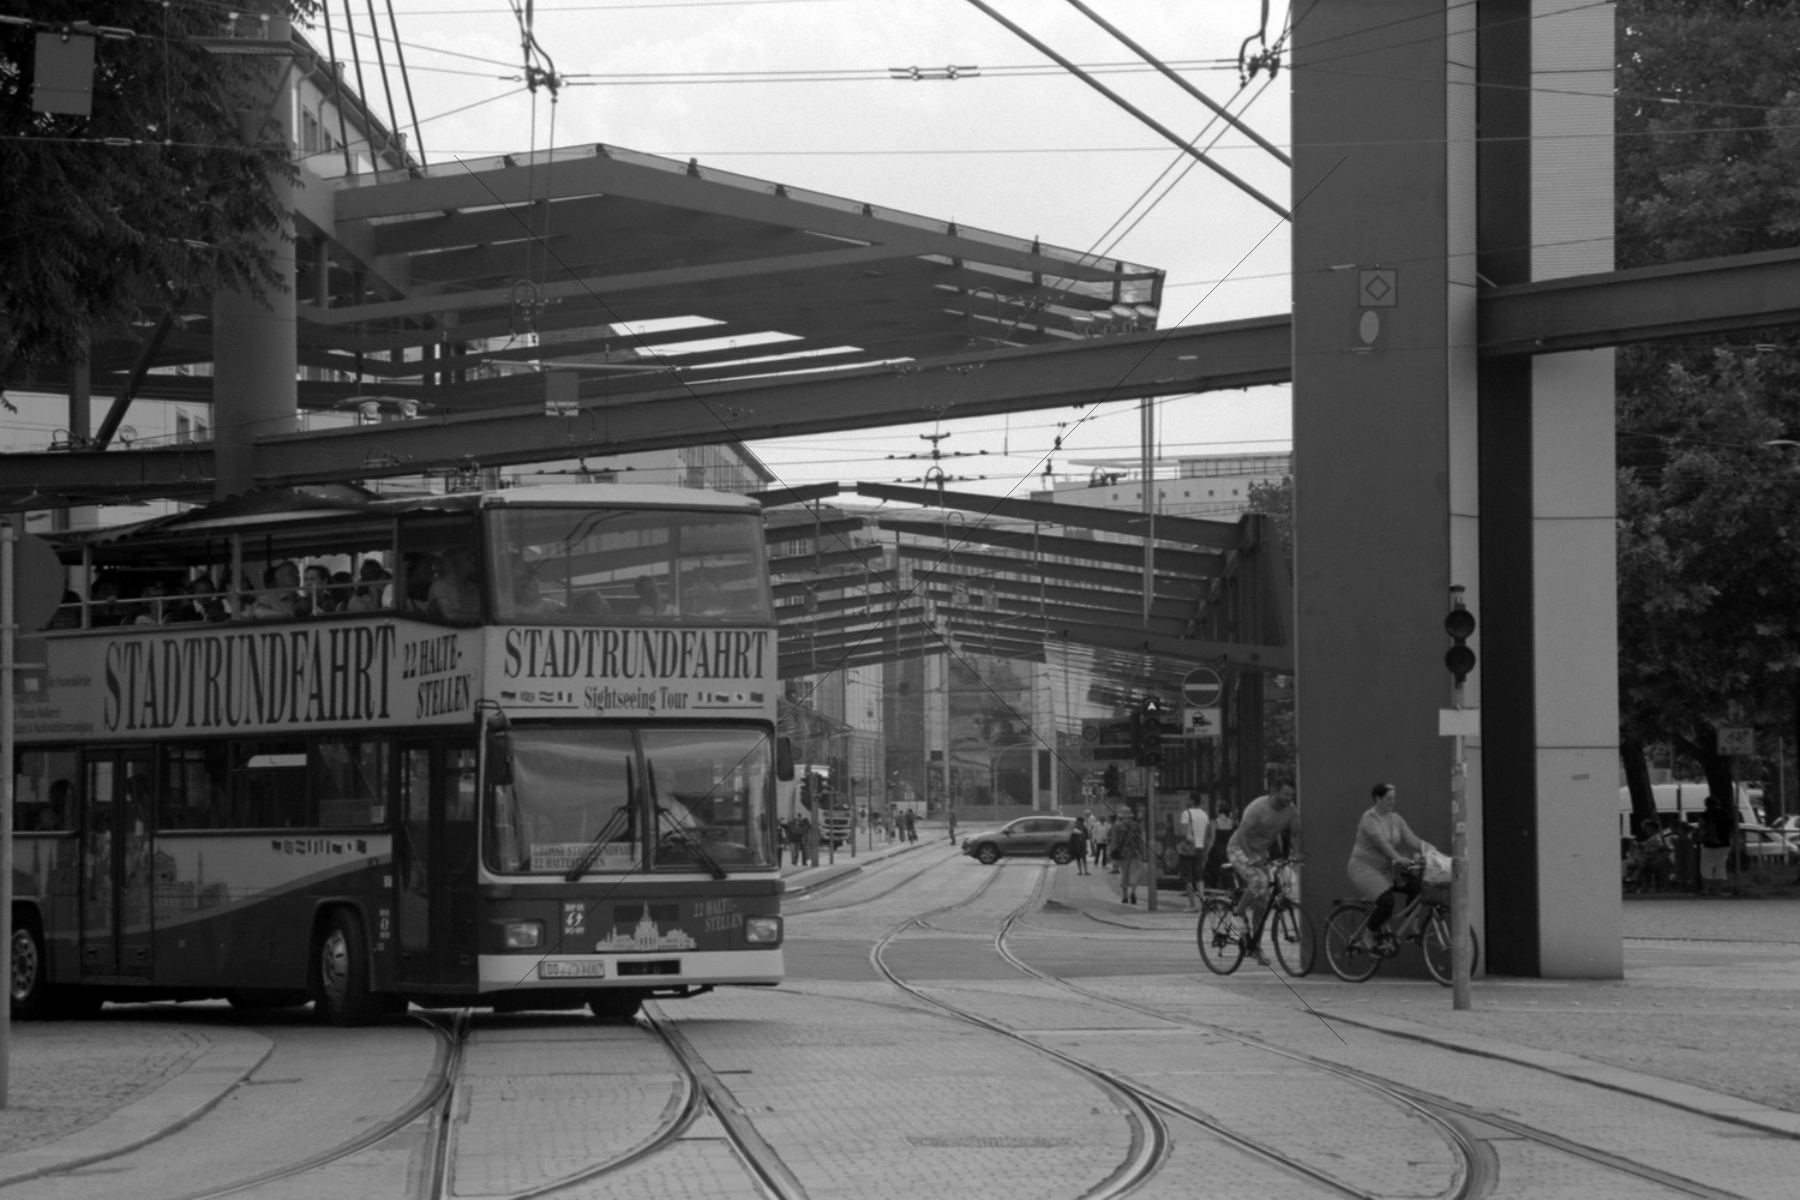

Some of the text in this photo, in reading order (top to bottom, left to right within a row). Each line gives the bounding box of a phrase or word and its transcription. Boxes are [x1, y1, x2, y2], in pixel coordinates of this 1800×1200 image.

[402, 633, 462, 679] 22 HALTE-
[504, 627, 769, 680] STADTRUNDFAHRT
[104, 624, 397, 732] STADTRUNDFAHRT
[416, 674, 470, 720] STELLEN
[584, 685, 689, 715] Sightseeing Tour
